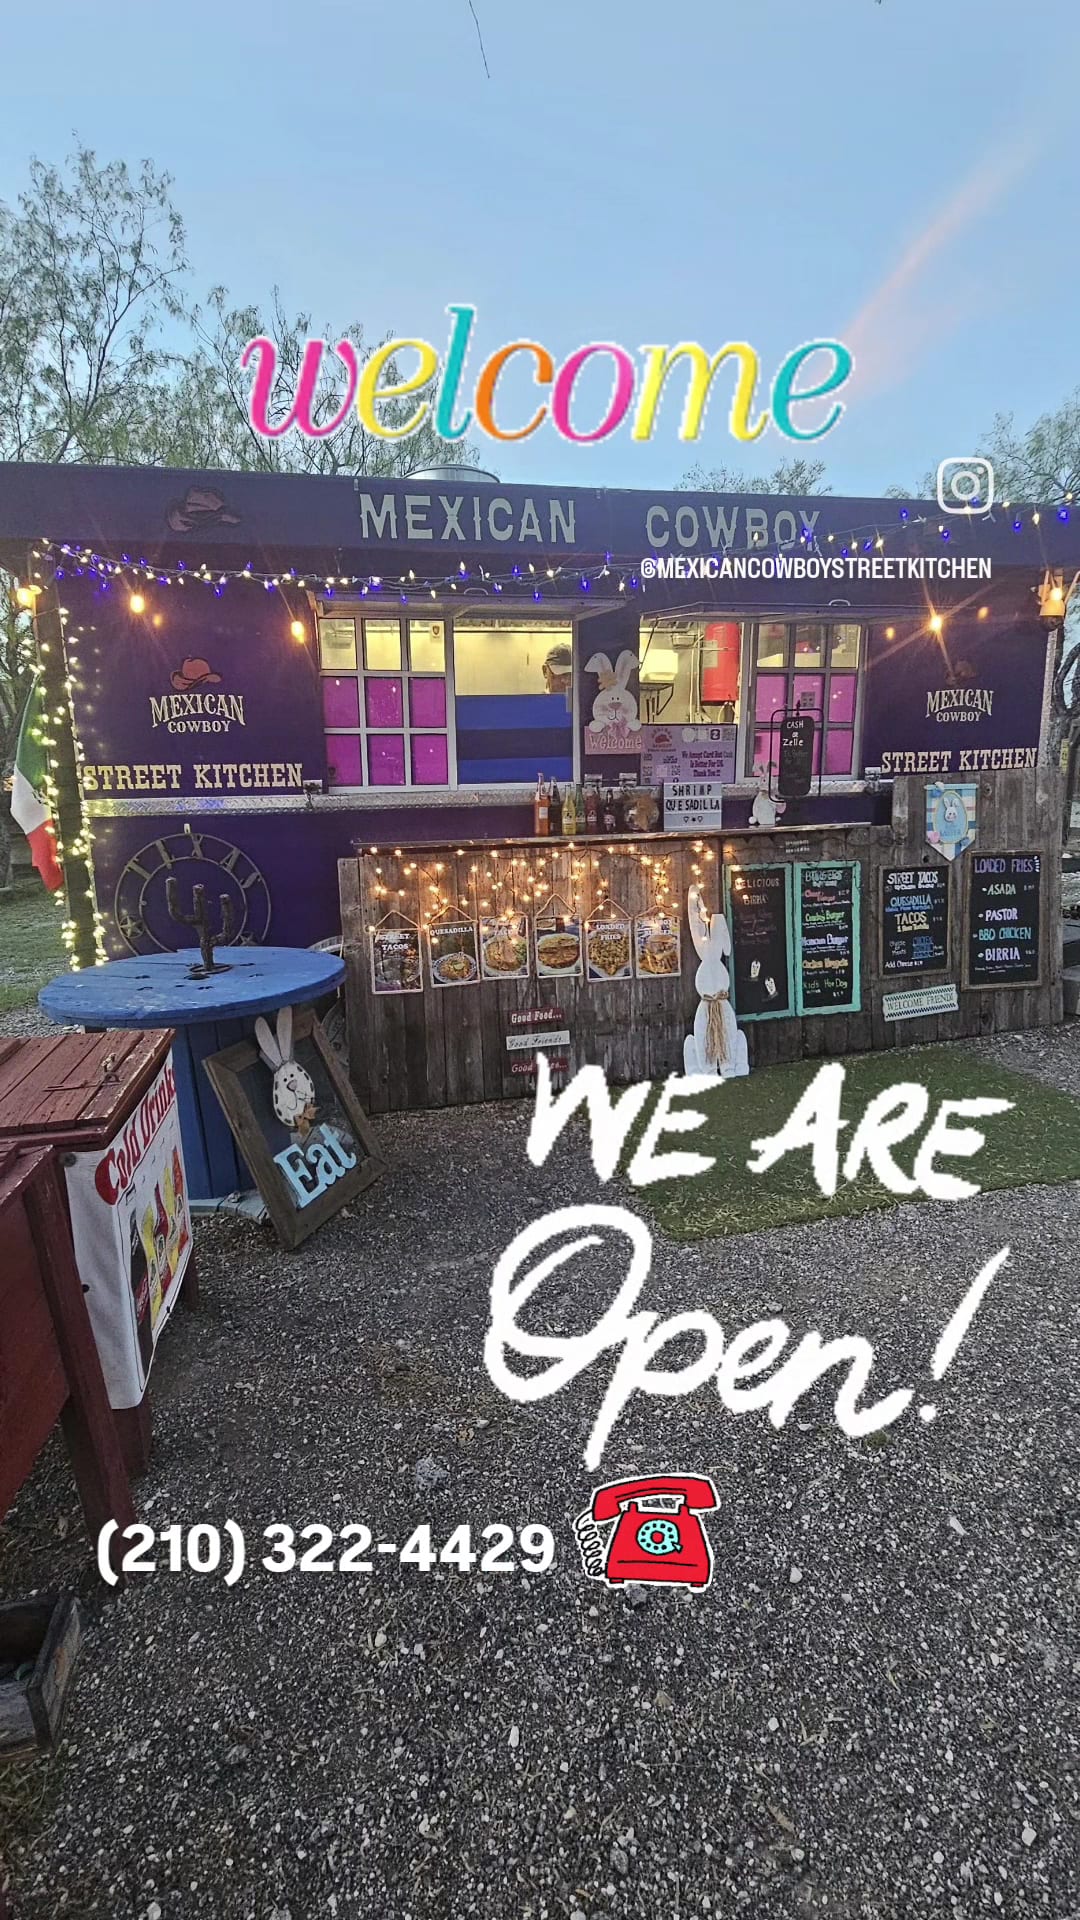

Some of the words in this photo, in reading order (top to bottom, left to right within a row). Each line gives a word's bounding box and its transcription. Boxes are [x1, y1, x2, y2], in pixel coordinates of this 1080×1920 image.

[359, 492, 576, 544] MEXICAN
[645, 505, 821, 553] COWBOY
[149, 693, 246, 728] MEXICAN
[925, 688, 994, 719] MEXICAN
[936, 711, 982, 723] COWBOY
[167, 720, 231, 733] COWBOY
[786, 720, 804, 729] CASH
[881, 751, 952, 774] STREET
[959, 747, 1038, 771] KITCHEN
[83, 764, 182, 791] STREET
[193, 763, 303, 789] KITCHEN
[974, 857, 1006, 873] LOADED
[1011, 858, 1034, 873] FRIES
[886, 871, 915, 885] STREET
[917, 870, 939, 884] TACOS
[987, 883, 1016, 896] ASADA
[890, 893, 933, 907] QUESADILLA
[894, 911, 927, 925] TACOS
[985, 907, 1018, 921] PASTOR
[999, 927, 1032, 940] CHICKEN
[381, 943, 409, 951] TACOS
[985, 947, 1020, 961] BIRRIA
[887, 997, 923, 1011] WELCOME
[511, 1011, 532, 1024] Good
[511, 1062, 533, 1073] Good
[94, 1112, 142, 1206] Cold
[273, 1122, 357, 1209] Eat
